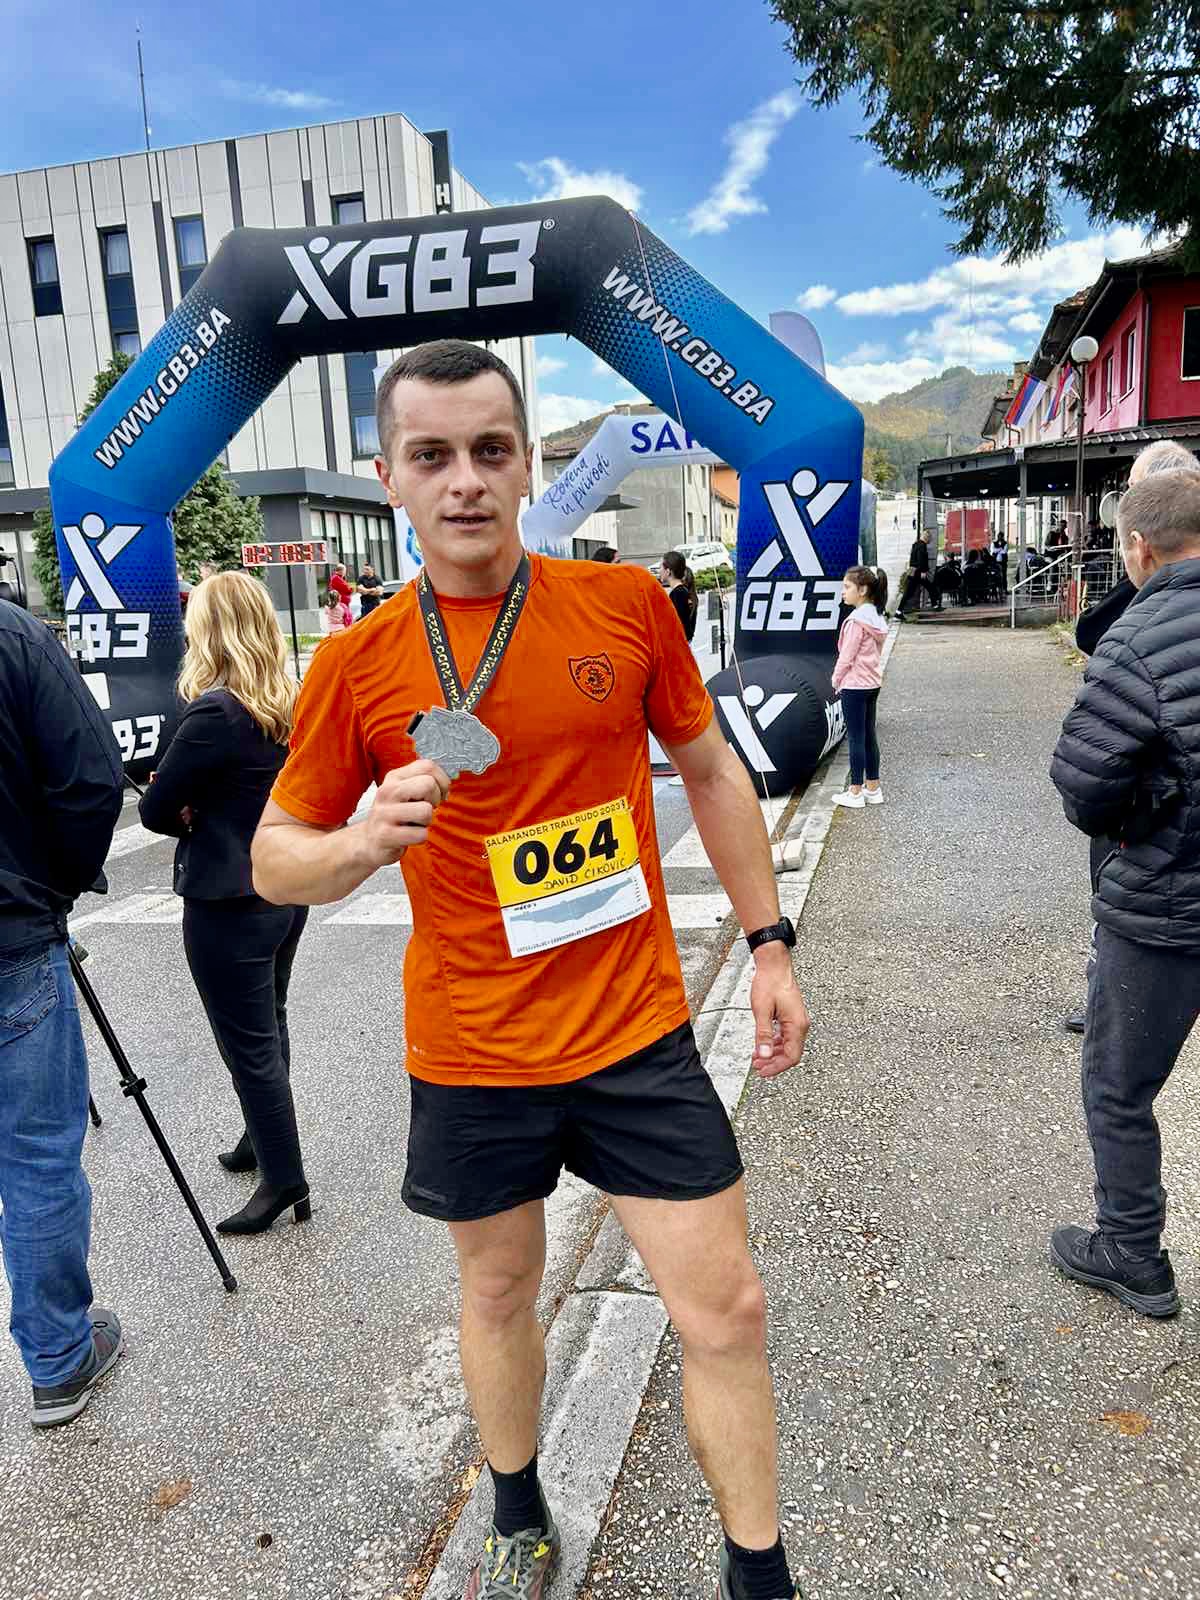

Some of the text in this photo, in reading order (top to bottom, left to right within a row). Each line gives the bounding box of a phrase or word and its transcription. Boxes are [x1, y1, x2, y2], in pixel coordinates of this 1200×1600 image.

[602, 266, 774, 424] WWW.GB3.BA
[95, 307, 232, 468] WWW.GB3.BA
[426, 611, 443, 645] 2023
[490, 581, 525, 656] SALAMANDER
[435, 645, 453, 680] RUDO
[477, 655, 500, 684] TRAIL
[486, 802, 621, 847] SALAMANDER TRAIL RUDO 2023
[513, 817, 619, 885] 064
[543, 874, 578, 890] DAVID
